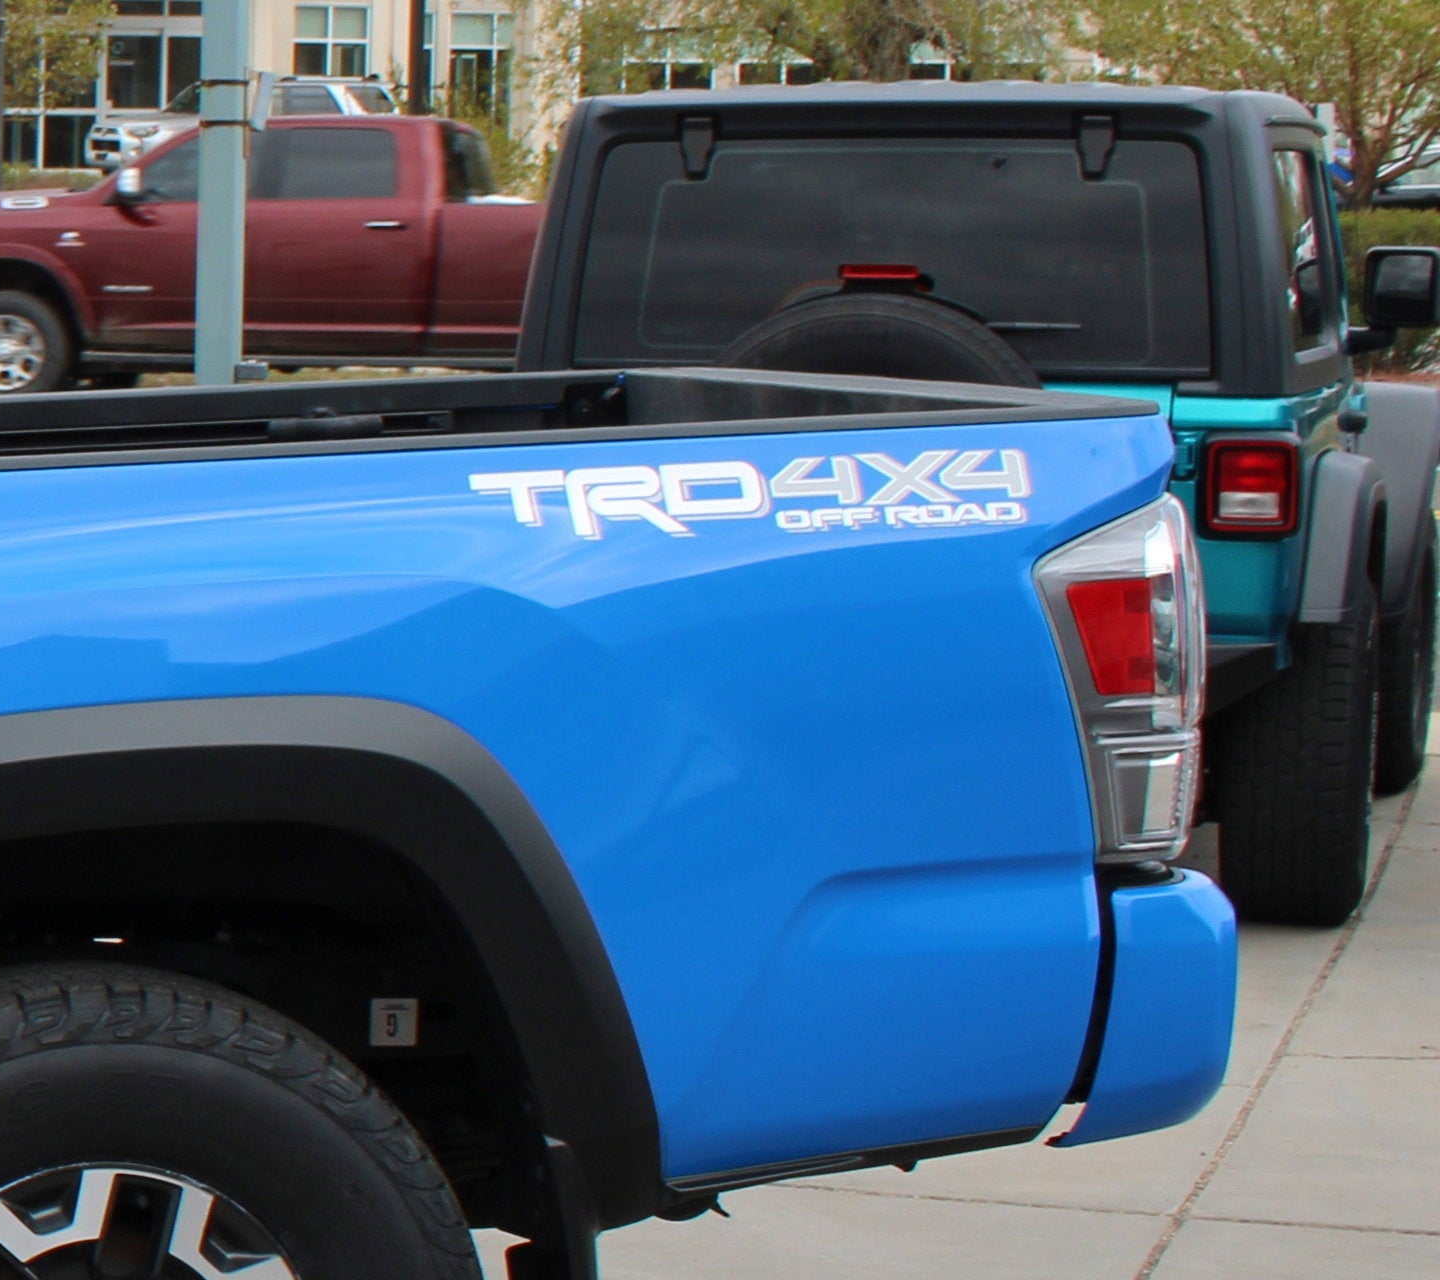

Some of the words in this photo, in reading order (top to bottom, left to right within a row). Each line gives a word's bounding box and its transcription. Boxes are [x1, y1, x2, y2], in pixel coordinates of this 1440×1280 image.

[468, 460, 771, 540] TRD
[774, 506, 879, 532] OFF
[884, 502, 1029, 529] ROAD
